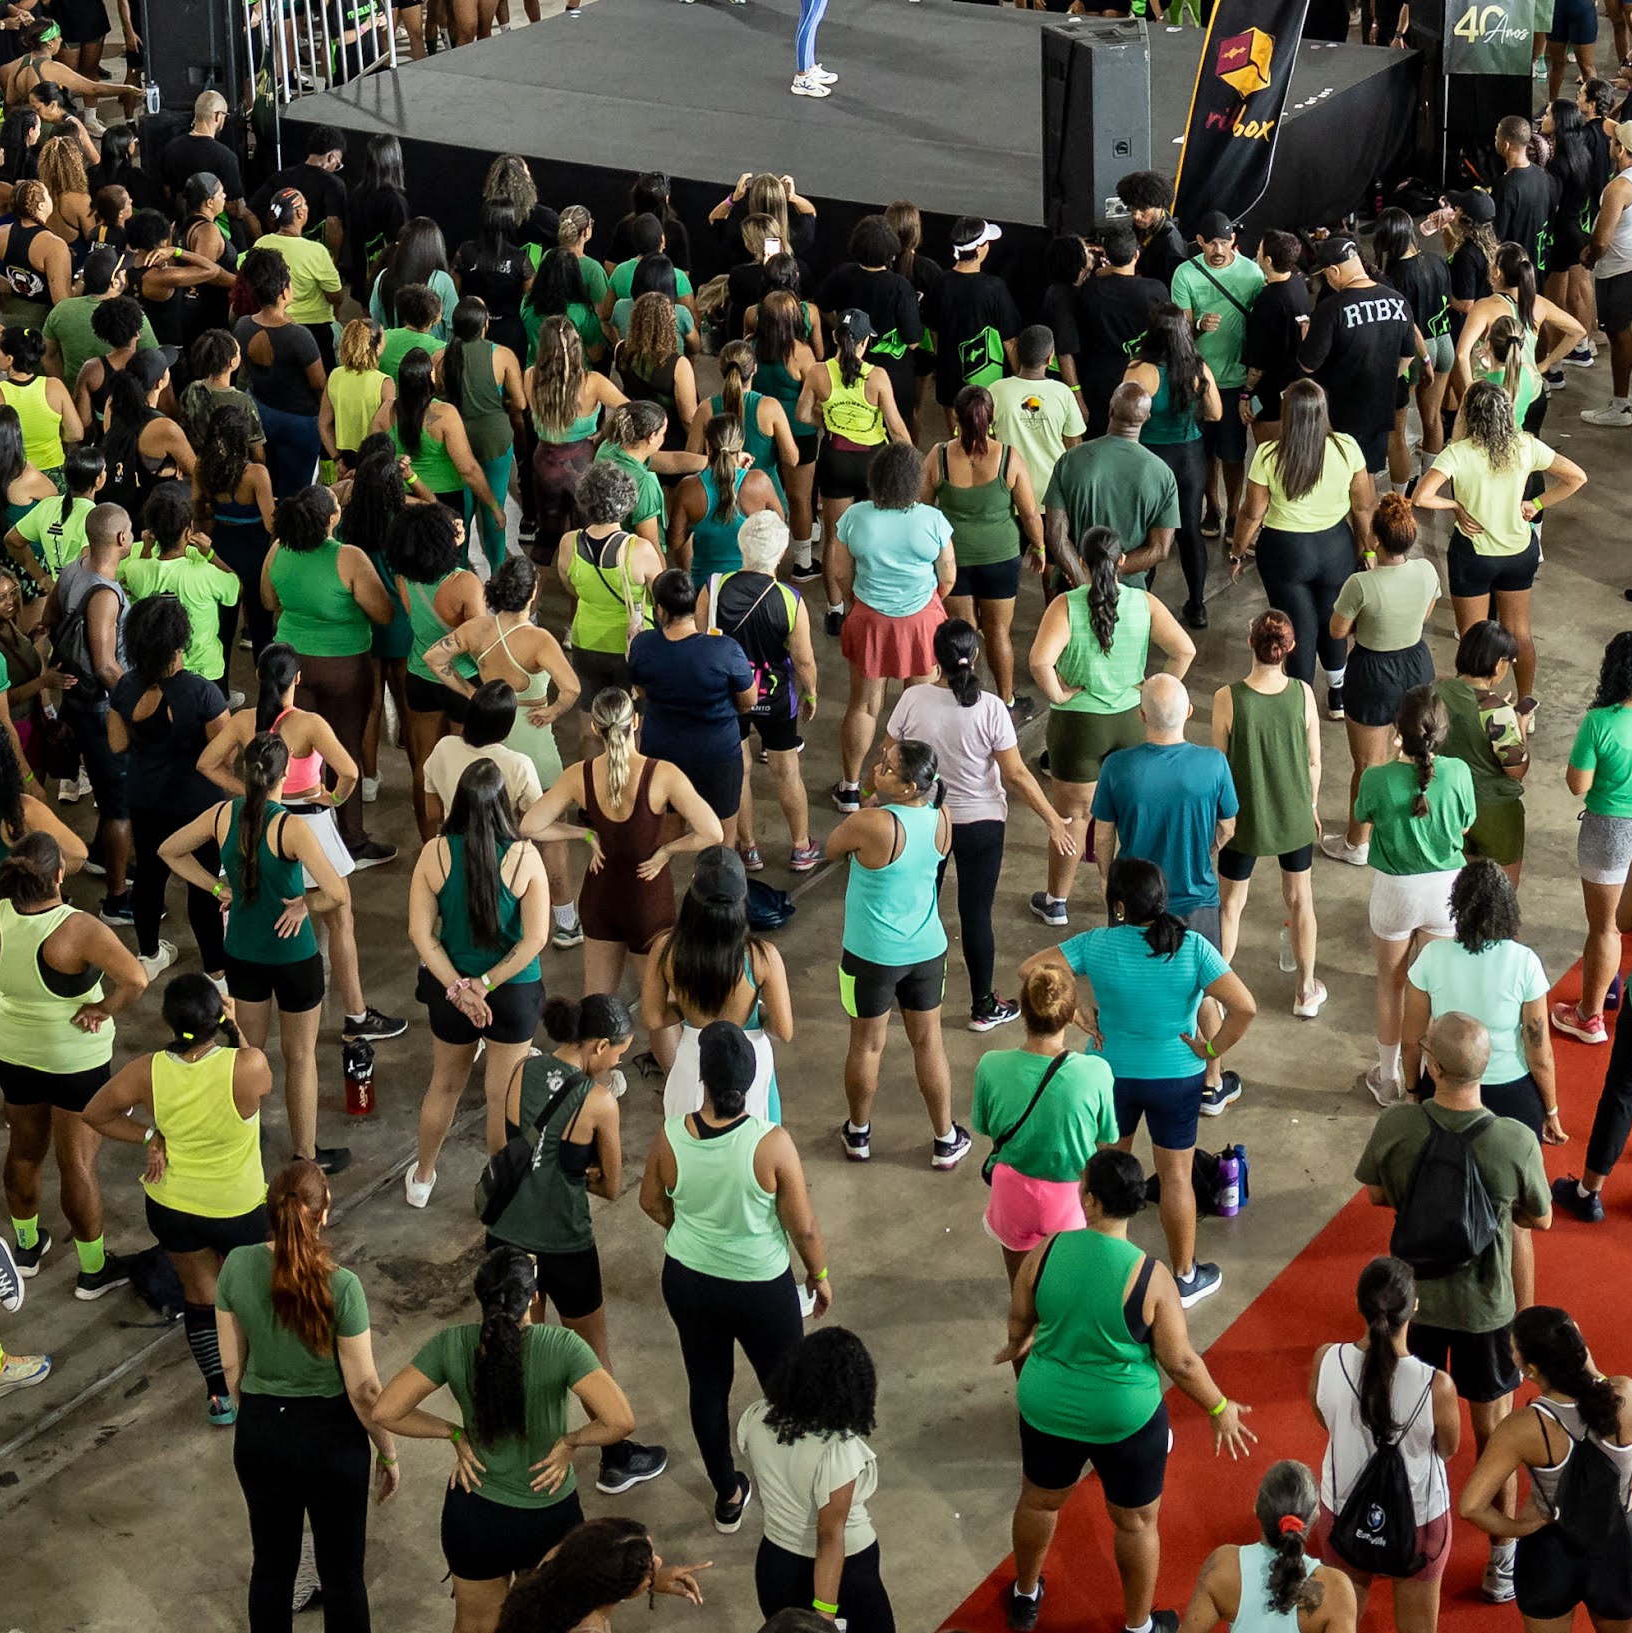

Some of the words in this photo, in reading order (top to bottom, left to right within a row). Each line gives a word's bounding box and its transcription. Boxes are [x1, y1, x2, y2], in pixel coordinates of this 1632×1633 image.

[1454, 4, 1507, 44] 40
[1484, 13, 1530, 45] Anos
[1343, 297, 1408, 329] RTBX
